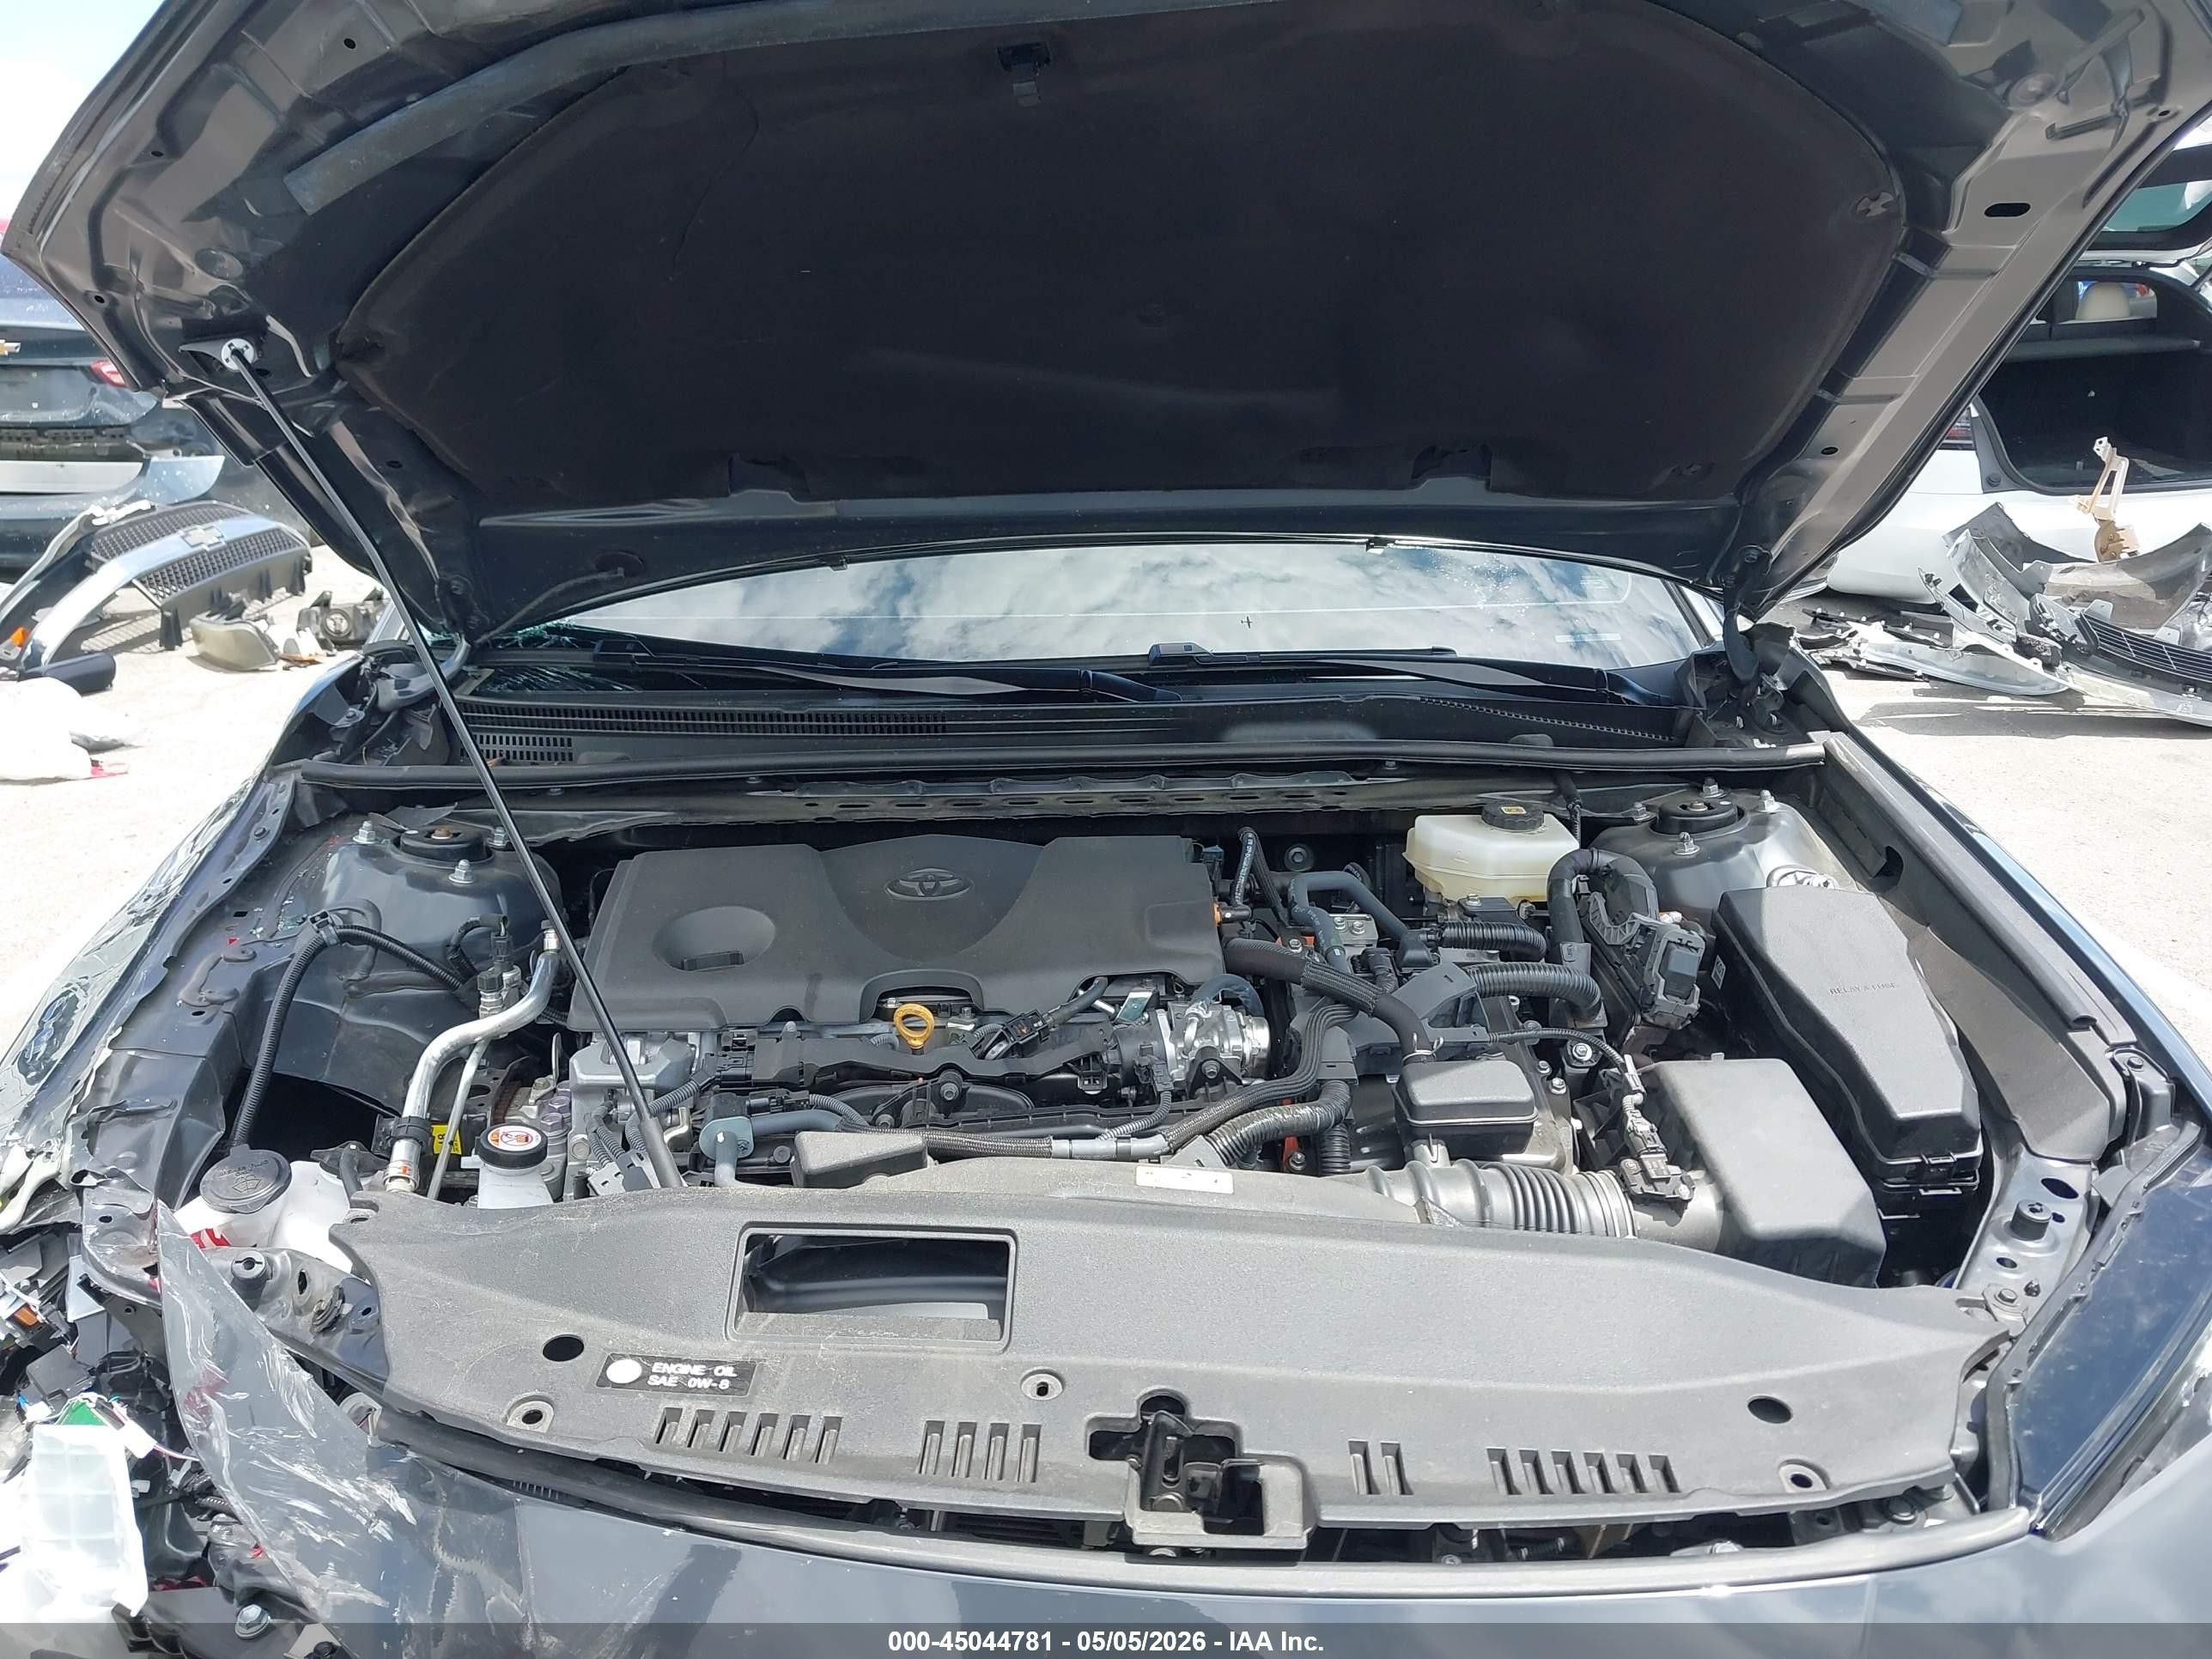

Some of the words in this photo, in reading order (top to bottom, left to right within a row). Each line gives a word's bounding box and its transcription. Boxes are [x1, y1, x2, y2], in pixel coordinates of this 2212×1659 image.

[651, 1361, 707, 1376] ENGINE
[713, 1365, 738, 1377] OIL
[647, 1375, 678, 1387] SAE
[687, 1377, 730, 1390] 0W-8
